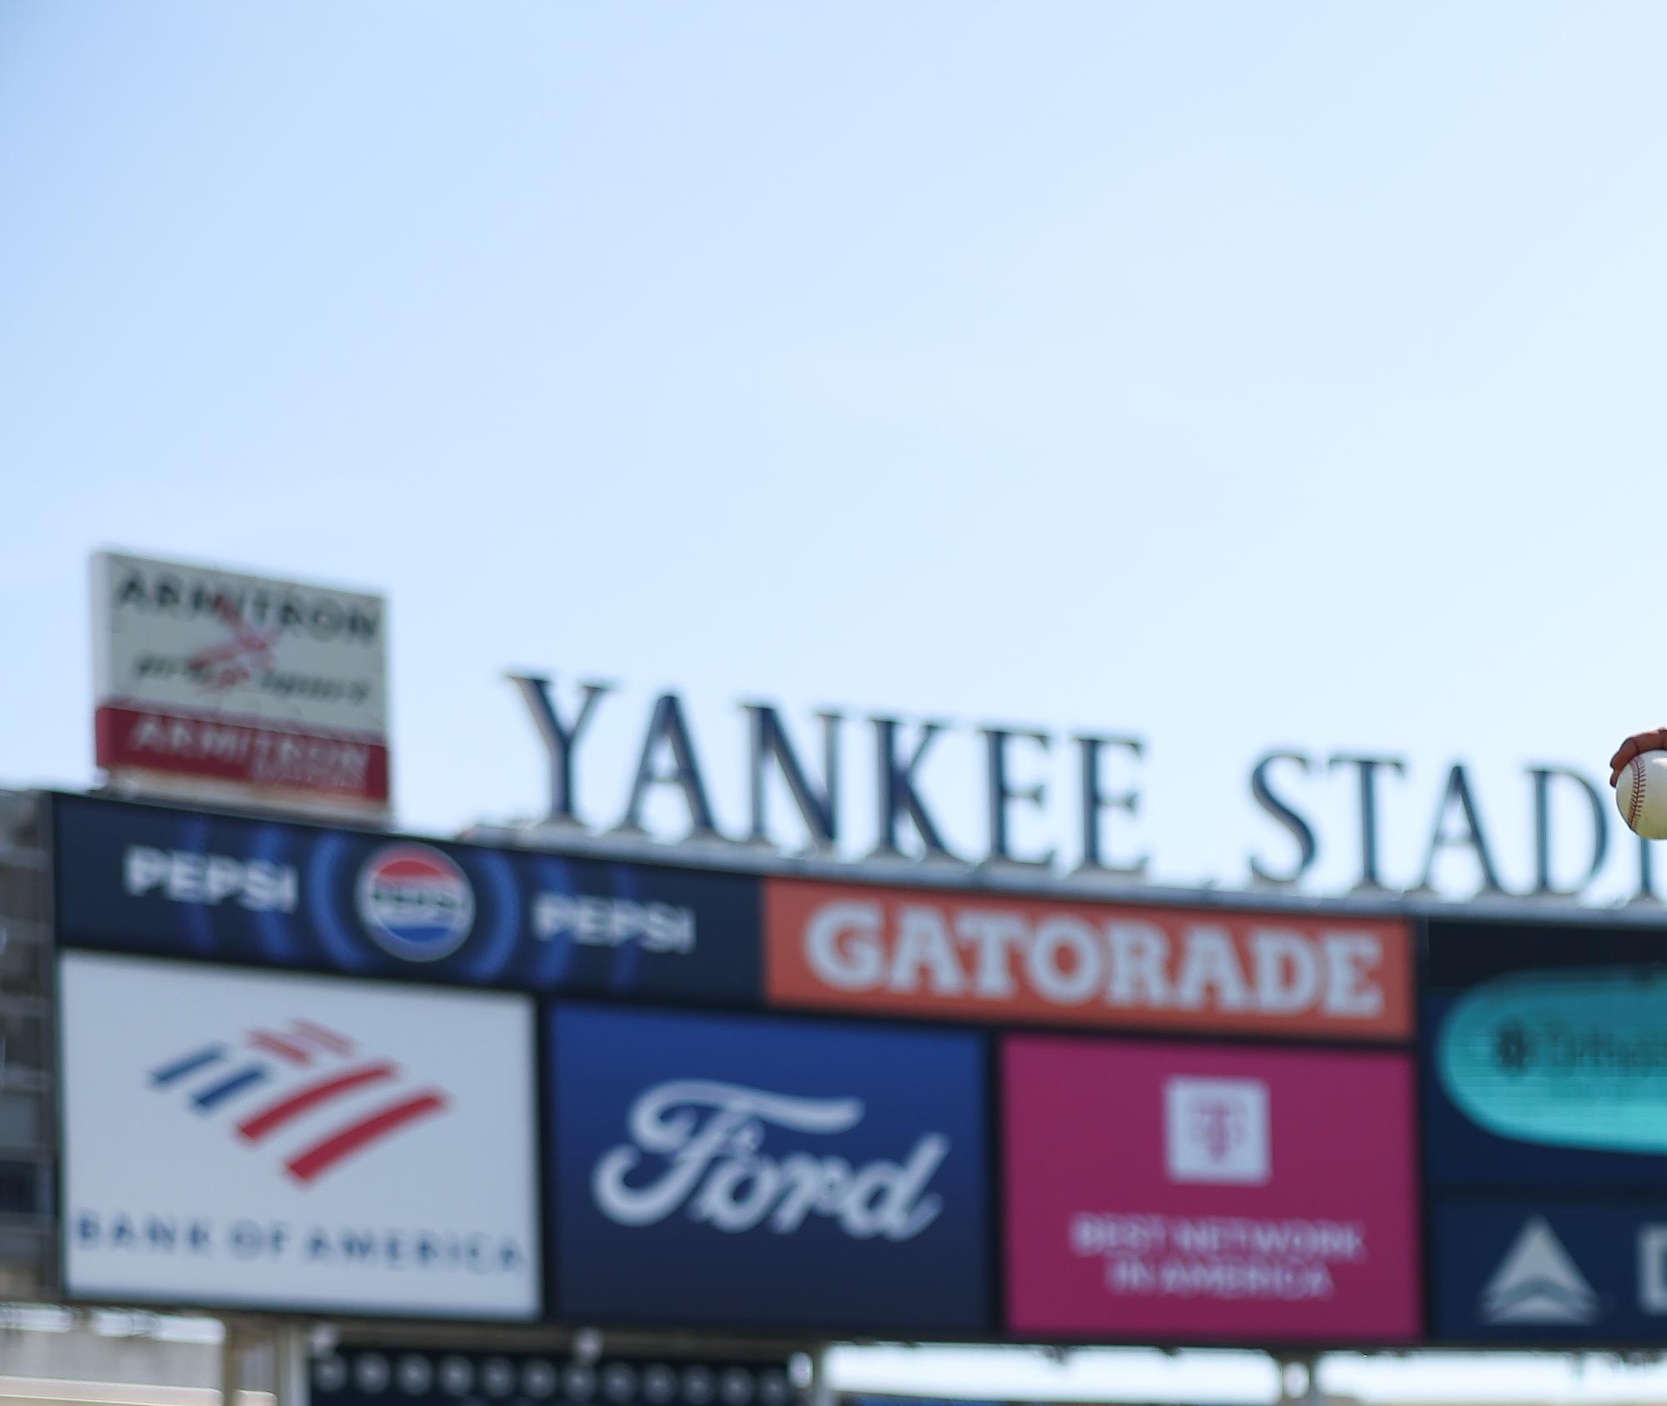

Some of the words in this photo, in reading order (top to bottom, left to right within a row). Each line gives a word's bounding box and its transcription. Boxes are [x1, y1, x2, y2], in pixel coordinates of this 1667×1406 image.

[503, 674, 1149, 873] YANKEE
[124, 844, 298, 914] PEPSI
[533, 891, 695, 955] PEPSI
[804, 898, 1386, 1020] GATORADE
[590, 1078, 951, 1243] Ford
[75, 1209, 219, 1256] BANK
[226, 1216, 291, 1266] OF
[306, 1220, 530, 1276] AMERICA
[1070, 1212, 1166, 1255] BEST
[1180, 1215, 1367, 1262] NETWORK
[1107, 1257, 1154, 1294] IN
[1158, 1261, 1335, 1300] AMERICA
